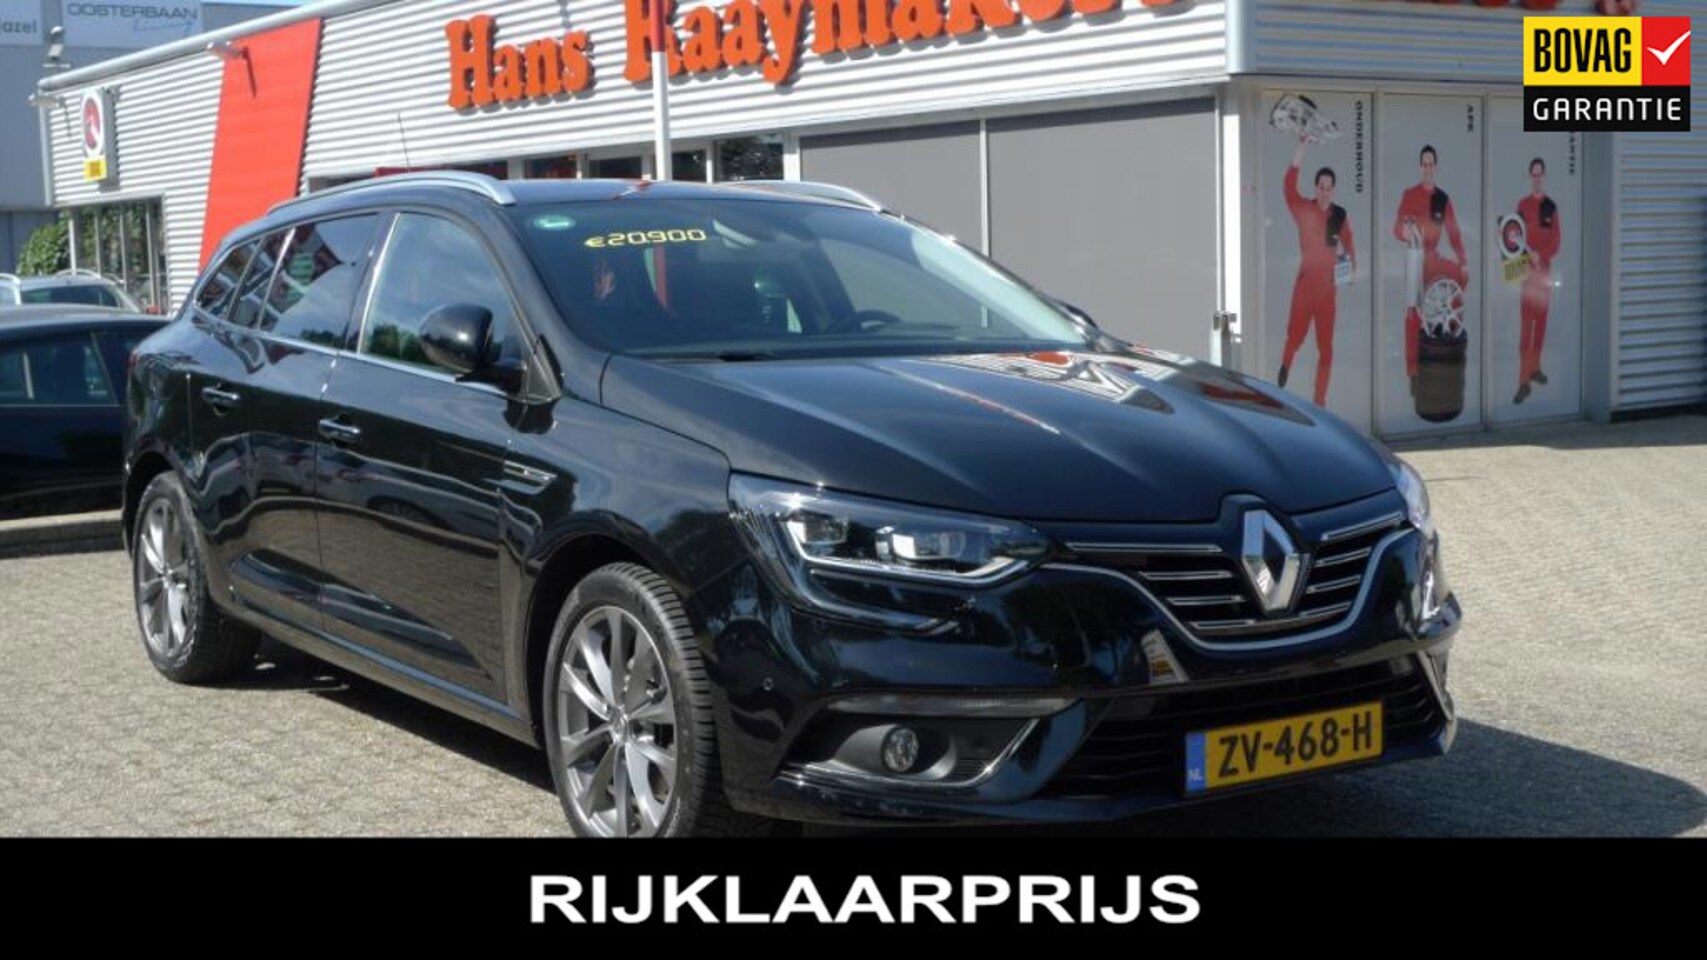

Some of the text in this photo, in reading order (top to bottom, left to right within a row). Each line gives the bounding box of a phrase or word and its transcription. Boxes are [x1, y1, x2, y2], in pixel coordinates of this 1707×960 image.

[0, 18, 38, 35] azel
[66, 3, 199, 20] OOSTERBAAN
[445, 14, 591, 109] Hans
[1355, 100, 1364, 194] ONDERHOUD
[1218, 711, 1372, 779] ZV-468-H
[1187, 769, 1204, 782] NL
